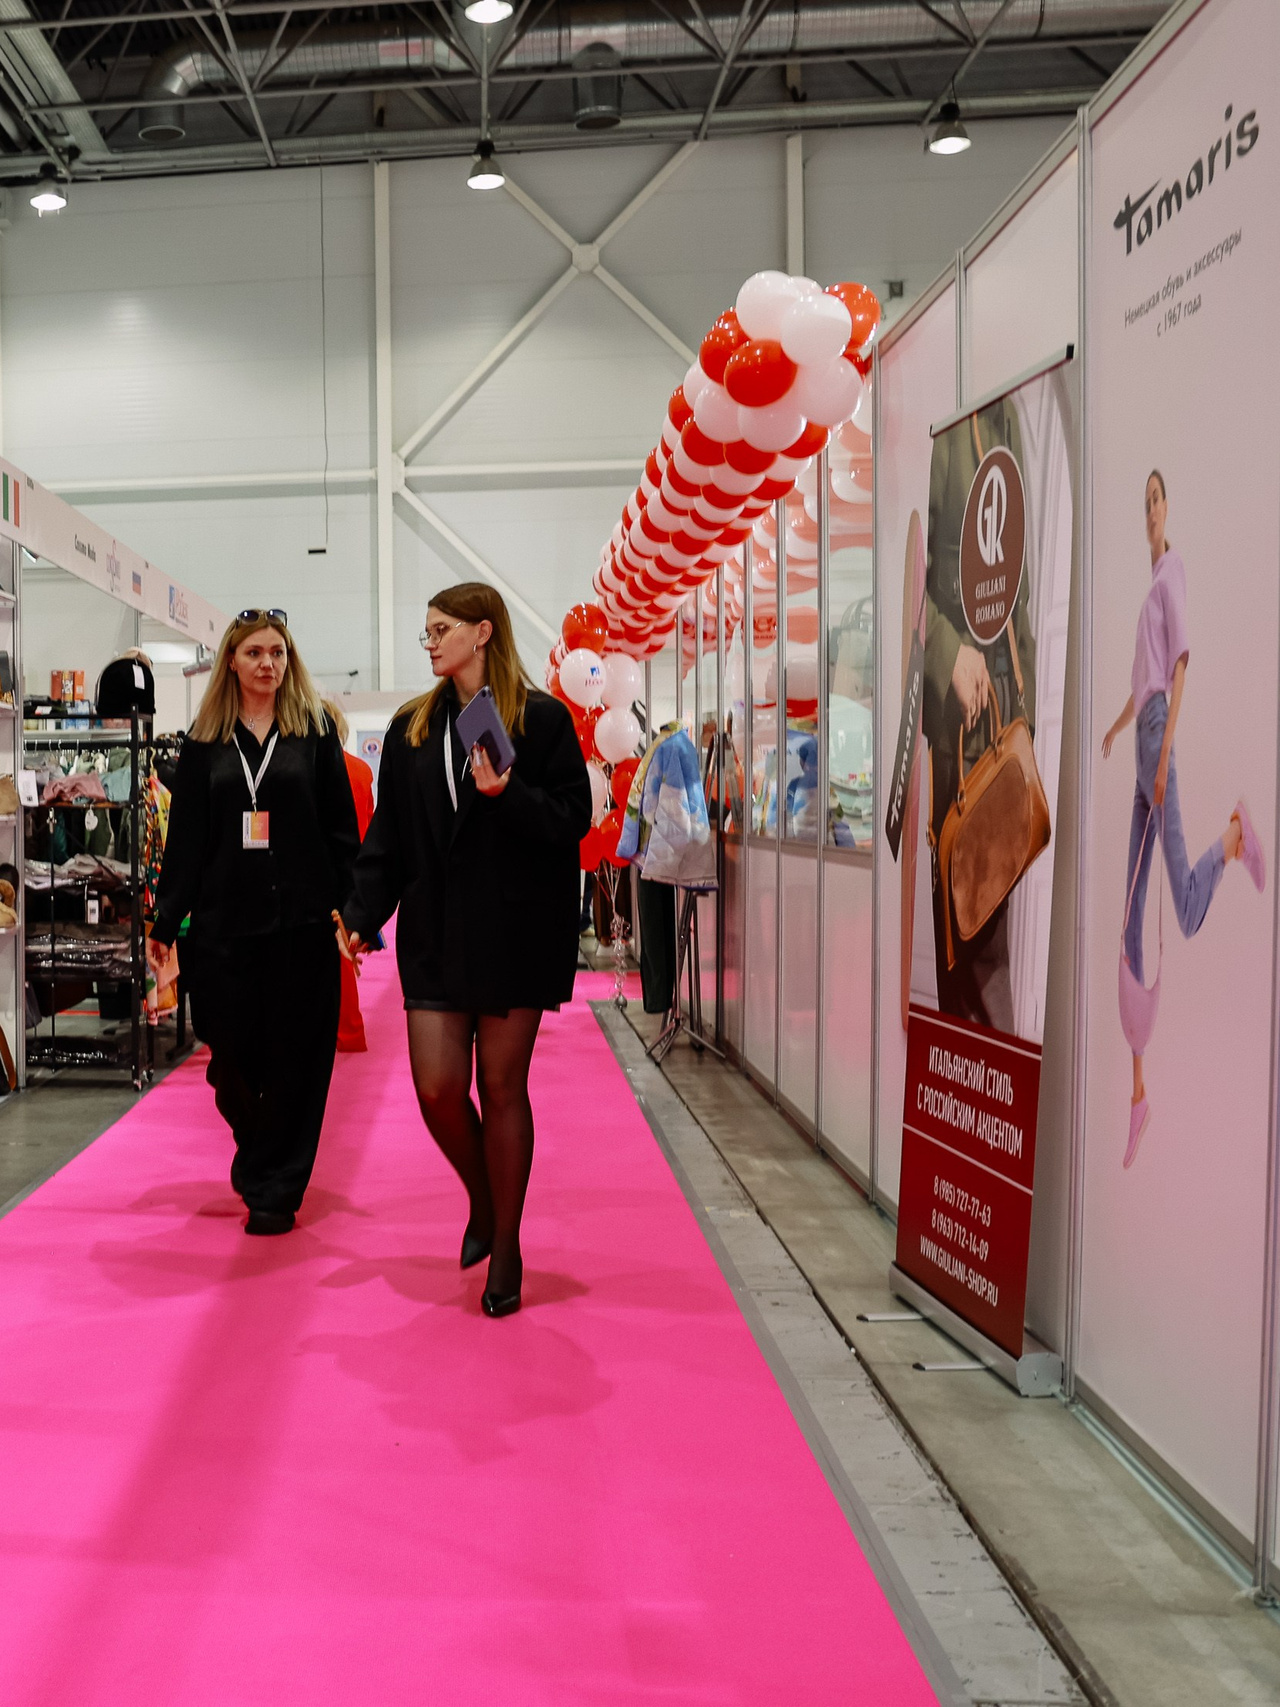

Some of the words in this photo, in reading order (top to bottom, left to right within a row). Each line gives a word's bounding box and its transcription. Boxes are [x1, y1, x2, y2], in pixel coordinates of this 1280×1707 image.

[1124, 290, 1160, 329] Немецкая
[1161, 274, 1185, 300] обувь
[1185, 267, 1192, 282] и
[1193, 226, 1242, 278] аксессуары
[1164, 300, 1182, 332] 1967
[1183, 292, 1202, 318] года
[975, 575, 1007, 600] GIULIANI
[975, 600, 1006, 625] ROMANO
[928, 1044, 986, 1094] ИТАЛЬЯНСКИЙ
[986, 1066, 1014, 1107] СТИЛЬ
[917, 1082, 923, 1111] С
[923, 1085, 976, 1136] РОССИЙСКИМ
[976, 1109, 1023, 1160] АКЦЕНТОМ
[933, 1174, 940, 1196] 8
[939, 1178, 956, 1207] (985)
[956, 1187, 992, 1228] 727-77-63
[931, 1208, 937, 1229] 8
[937, 1211, 954, 1241] (963)
[954, 1221, 989, 1262] 712-14-09
[920, 1234, 999, 1308] WWW.GIULIANI-SHOP.RU
